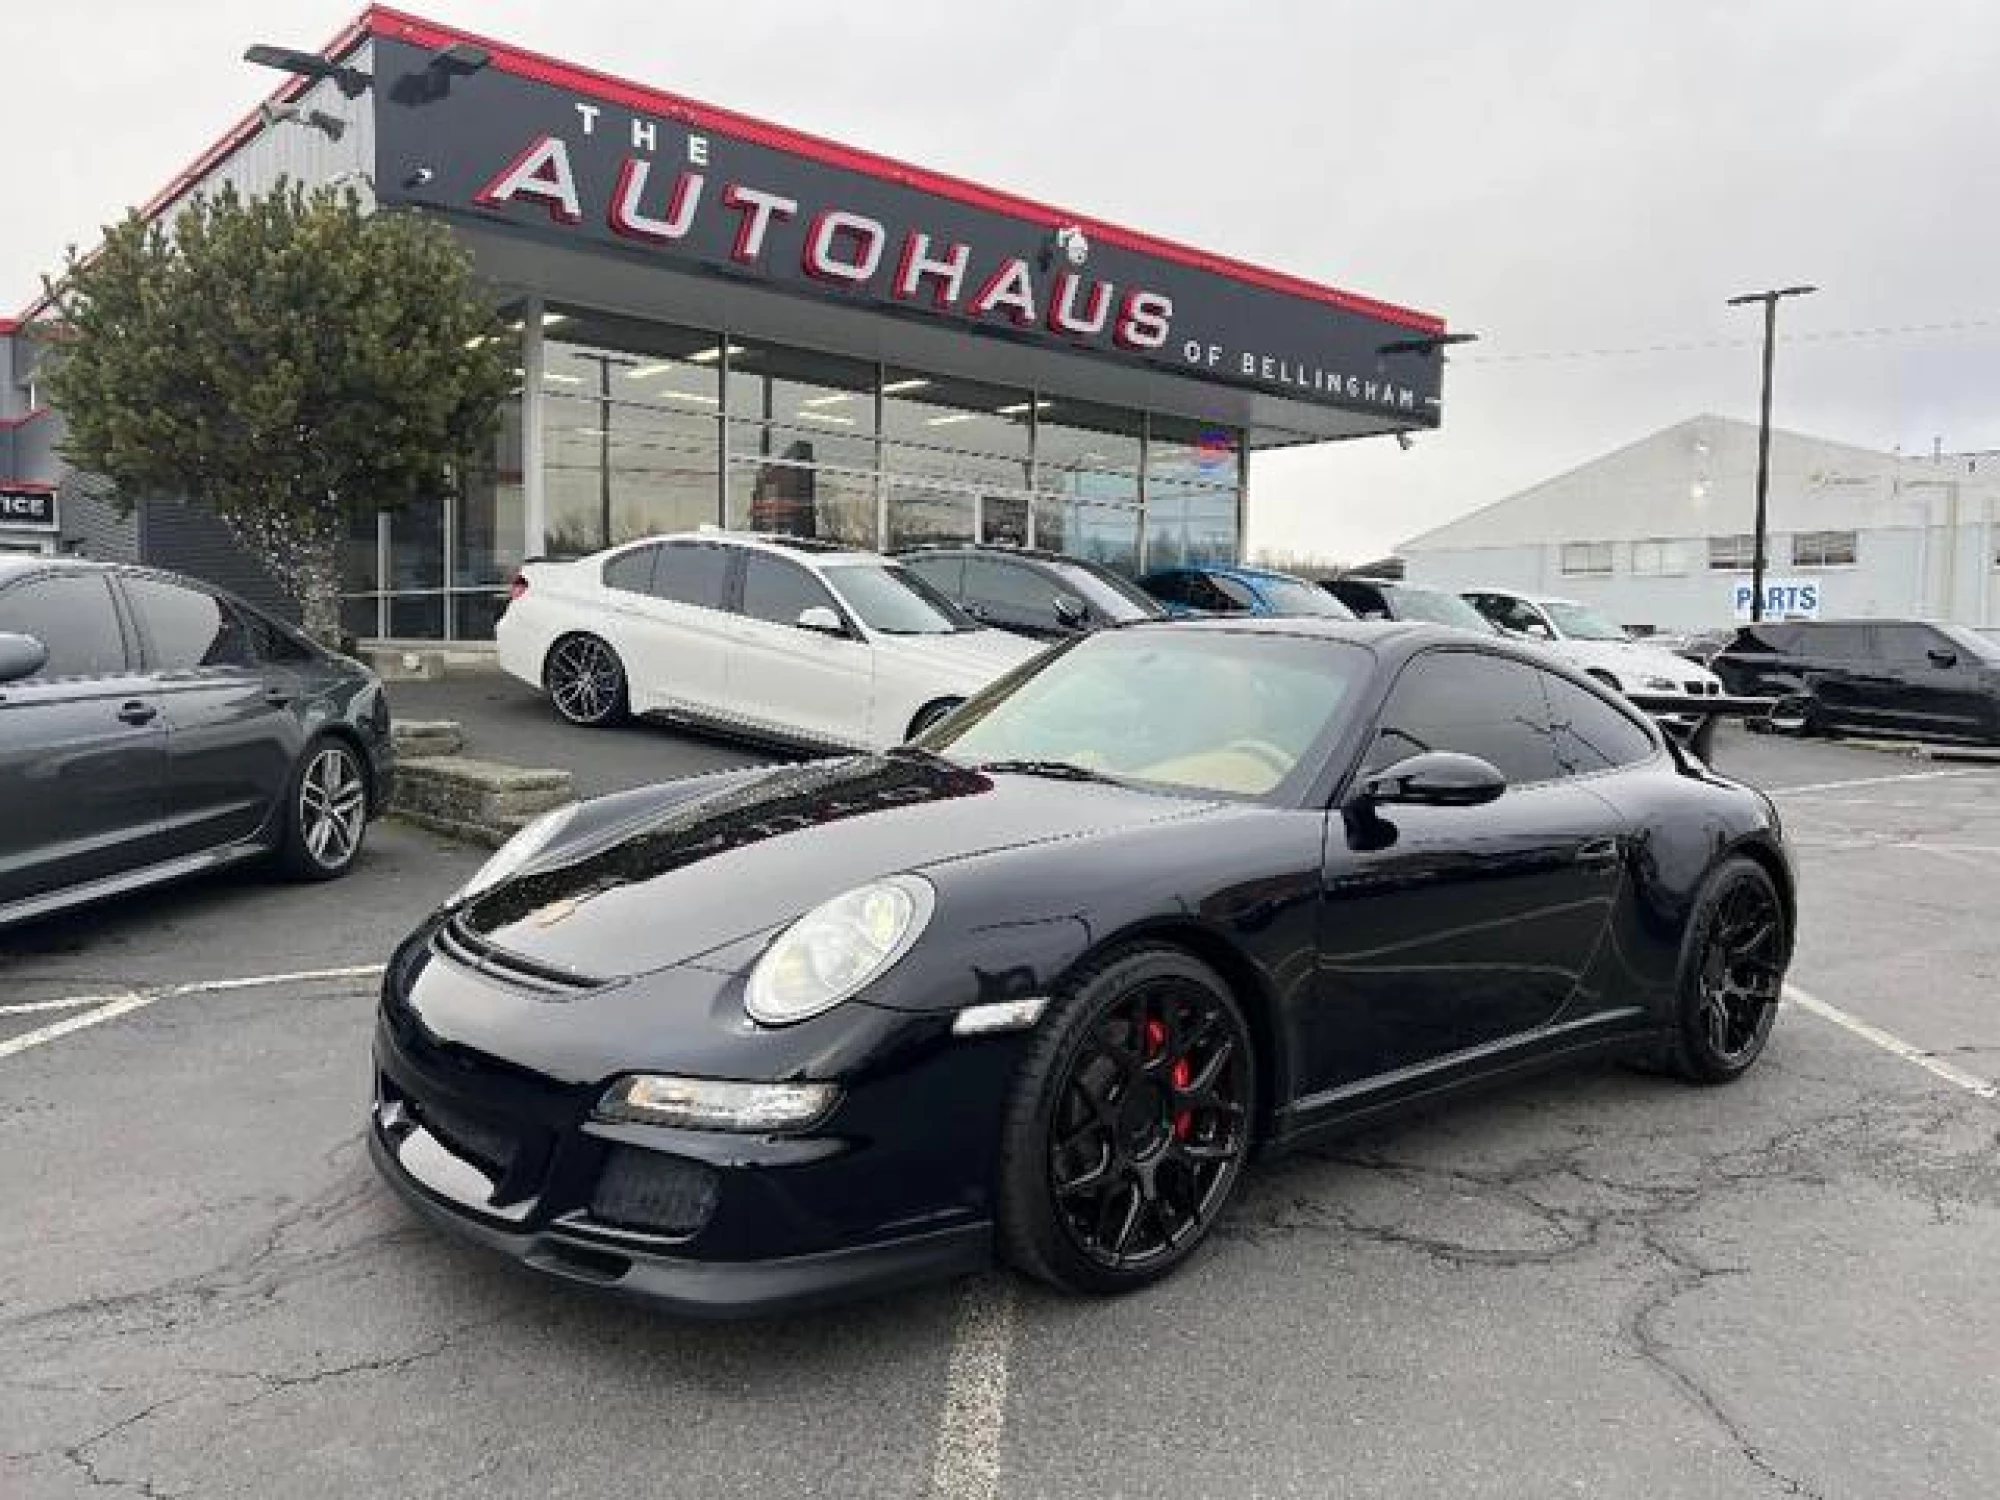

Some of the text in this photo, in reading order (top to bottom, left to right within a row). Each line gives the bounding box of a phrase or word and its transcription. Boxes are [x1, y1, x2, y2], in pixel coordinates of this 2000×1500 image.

[574, 102, 709, 166] THE
[475, 134, 1173, 350] AUTOHAUS
[1184, 340, 1414, 407] OF BELLINGHAM
[0, 496, 44, 516] ICE
